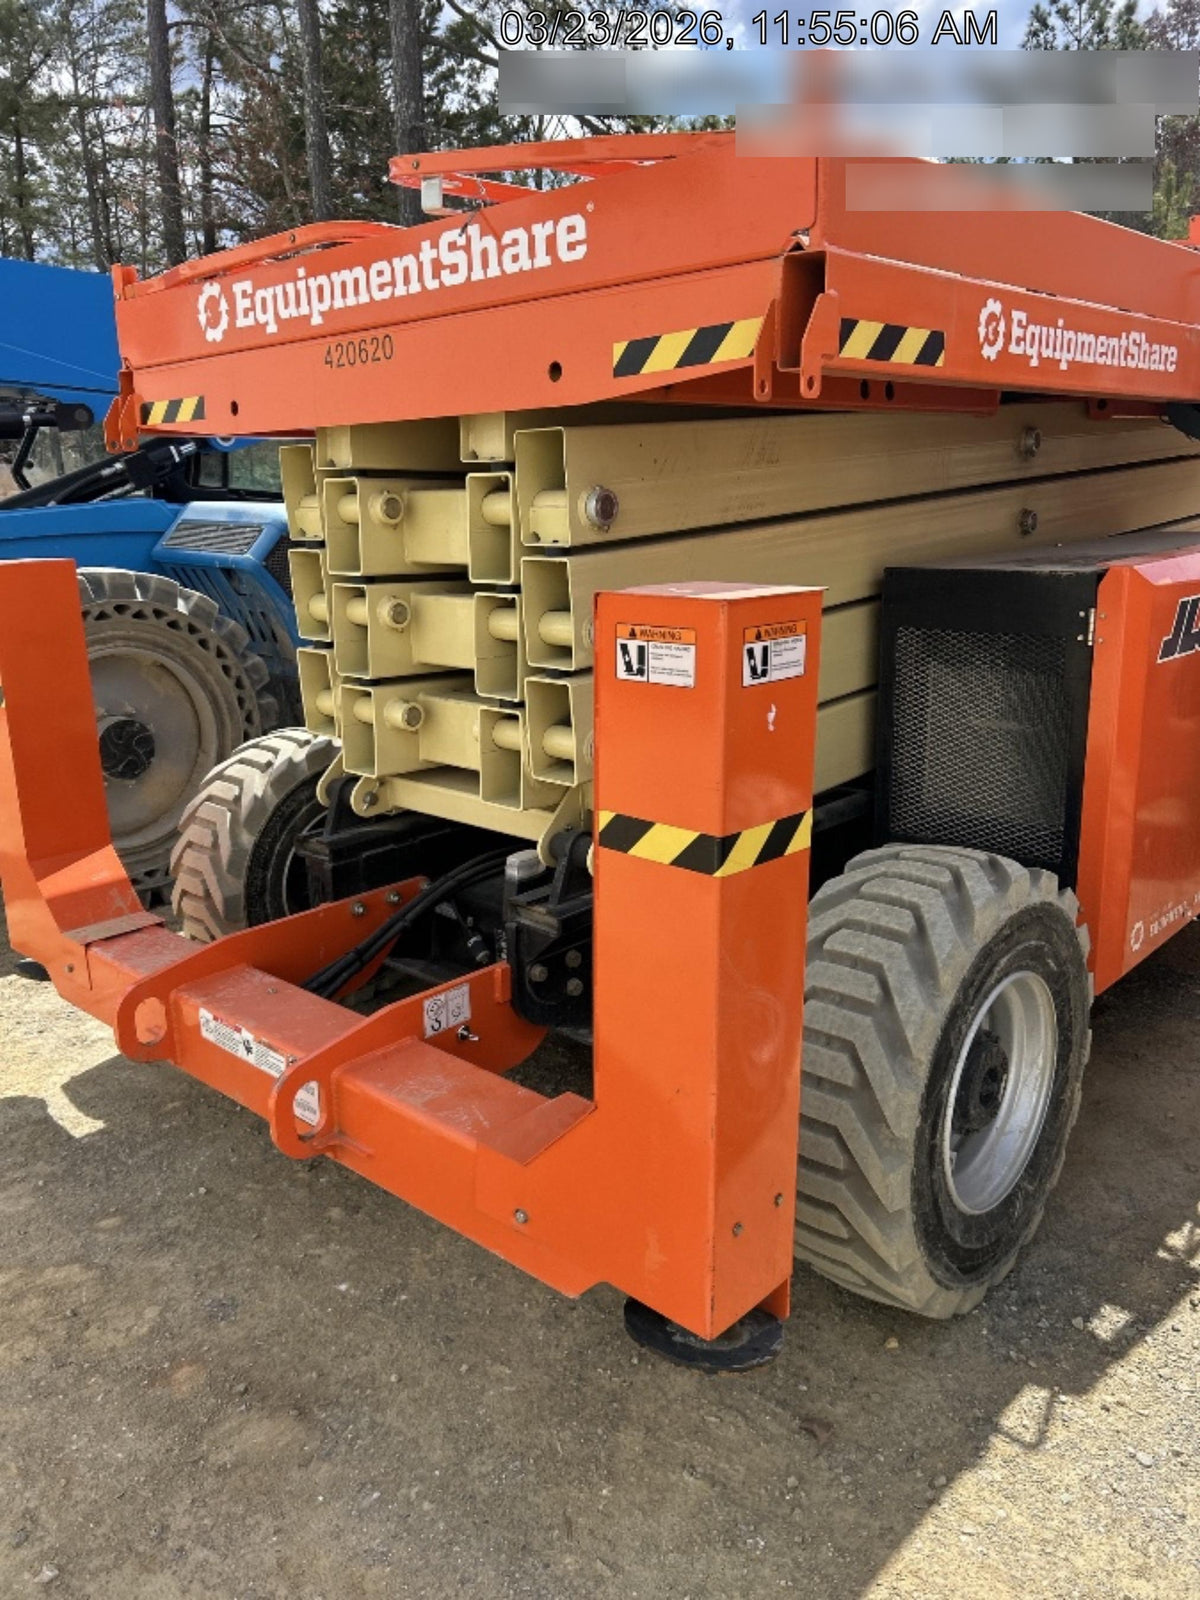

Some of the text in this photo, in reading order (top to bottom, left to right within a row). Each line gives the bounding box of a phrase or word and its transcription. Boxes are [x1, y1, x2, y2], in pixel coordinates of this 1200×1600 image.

[232, 213, 588, 335] EquipmentShare
[324, 333, 394, 369] 420620
[1008, 308, 1178, 373] EquipmentShare
[1156, 593, 1200, 664] JL
